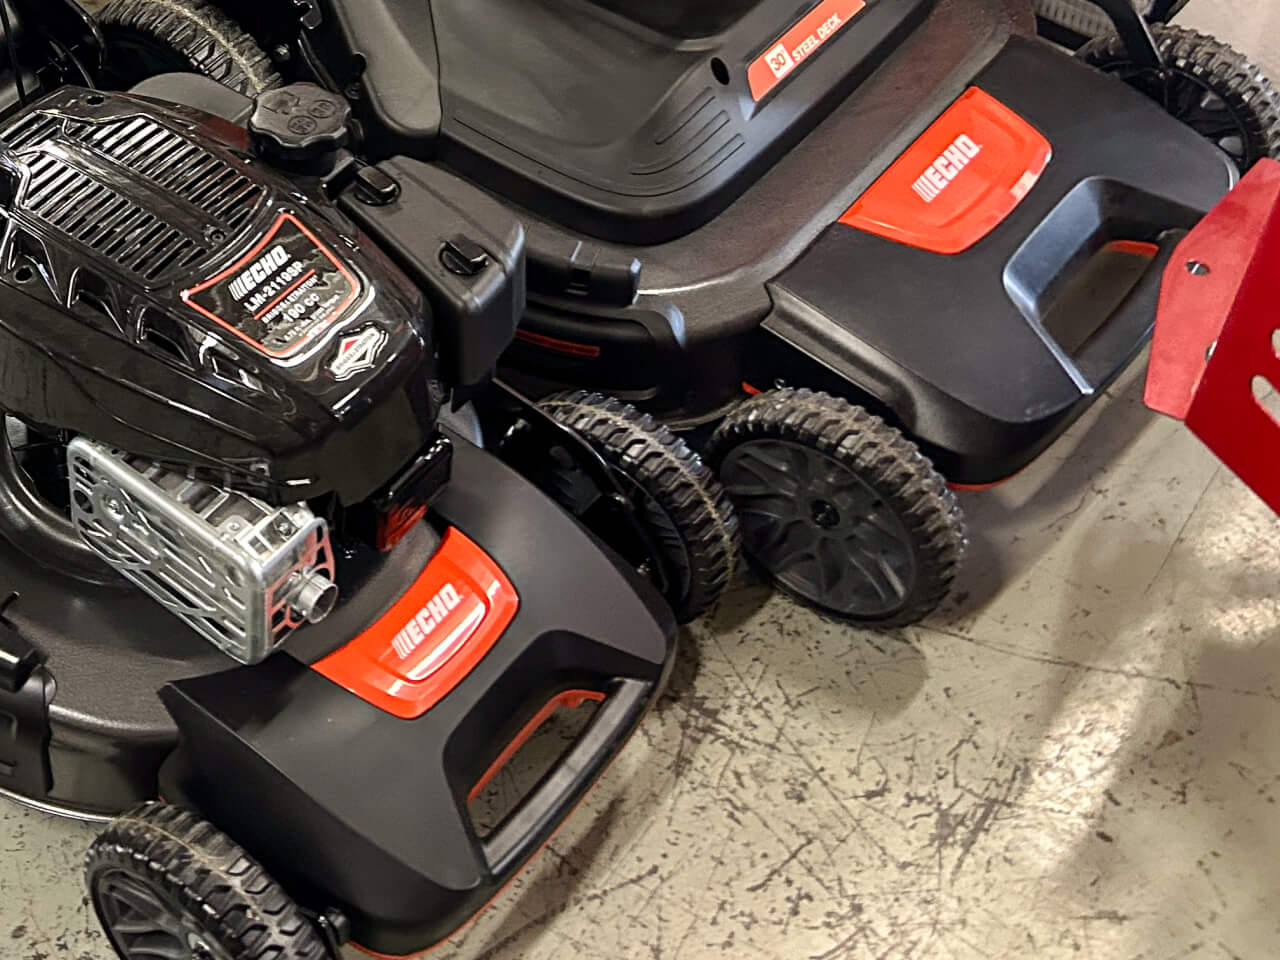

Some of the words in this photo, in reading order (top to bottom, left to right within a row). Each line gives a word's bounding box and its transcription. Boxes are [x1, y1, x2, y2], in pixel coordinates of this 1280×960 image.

[791, 36, 821, 61] STEEL
[816, 12, 842, 40] DECK
[921, 133, 980, 196] ECHO
[235, 244, 291, 297] ECHO
[244, 261, 306, 312] LM-2119SP
[282, 301, 307, 324] 190
[304, 292, 320, 308] cc
[402, 582, 463, 651] ECHO
